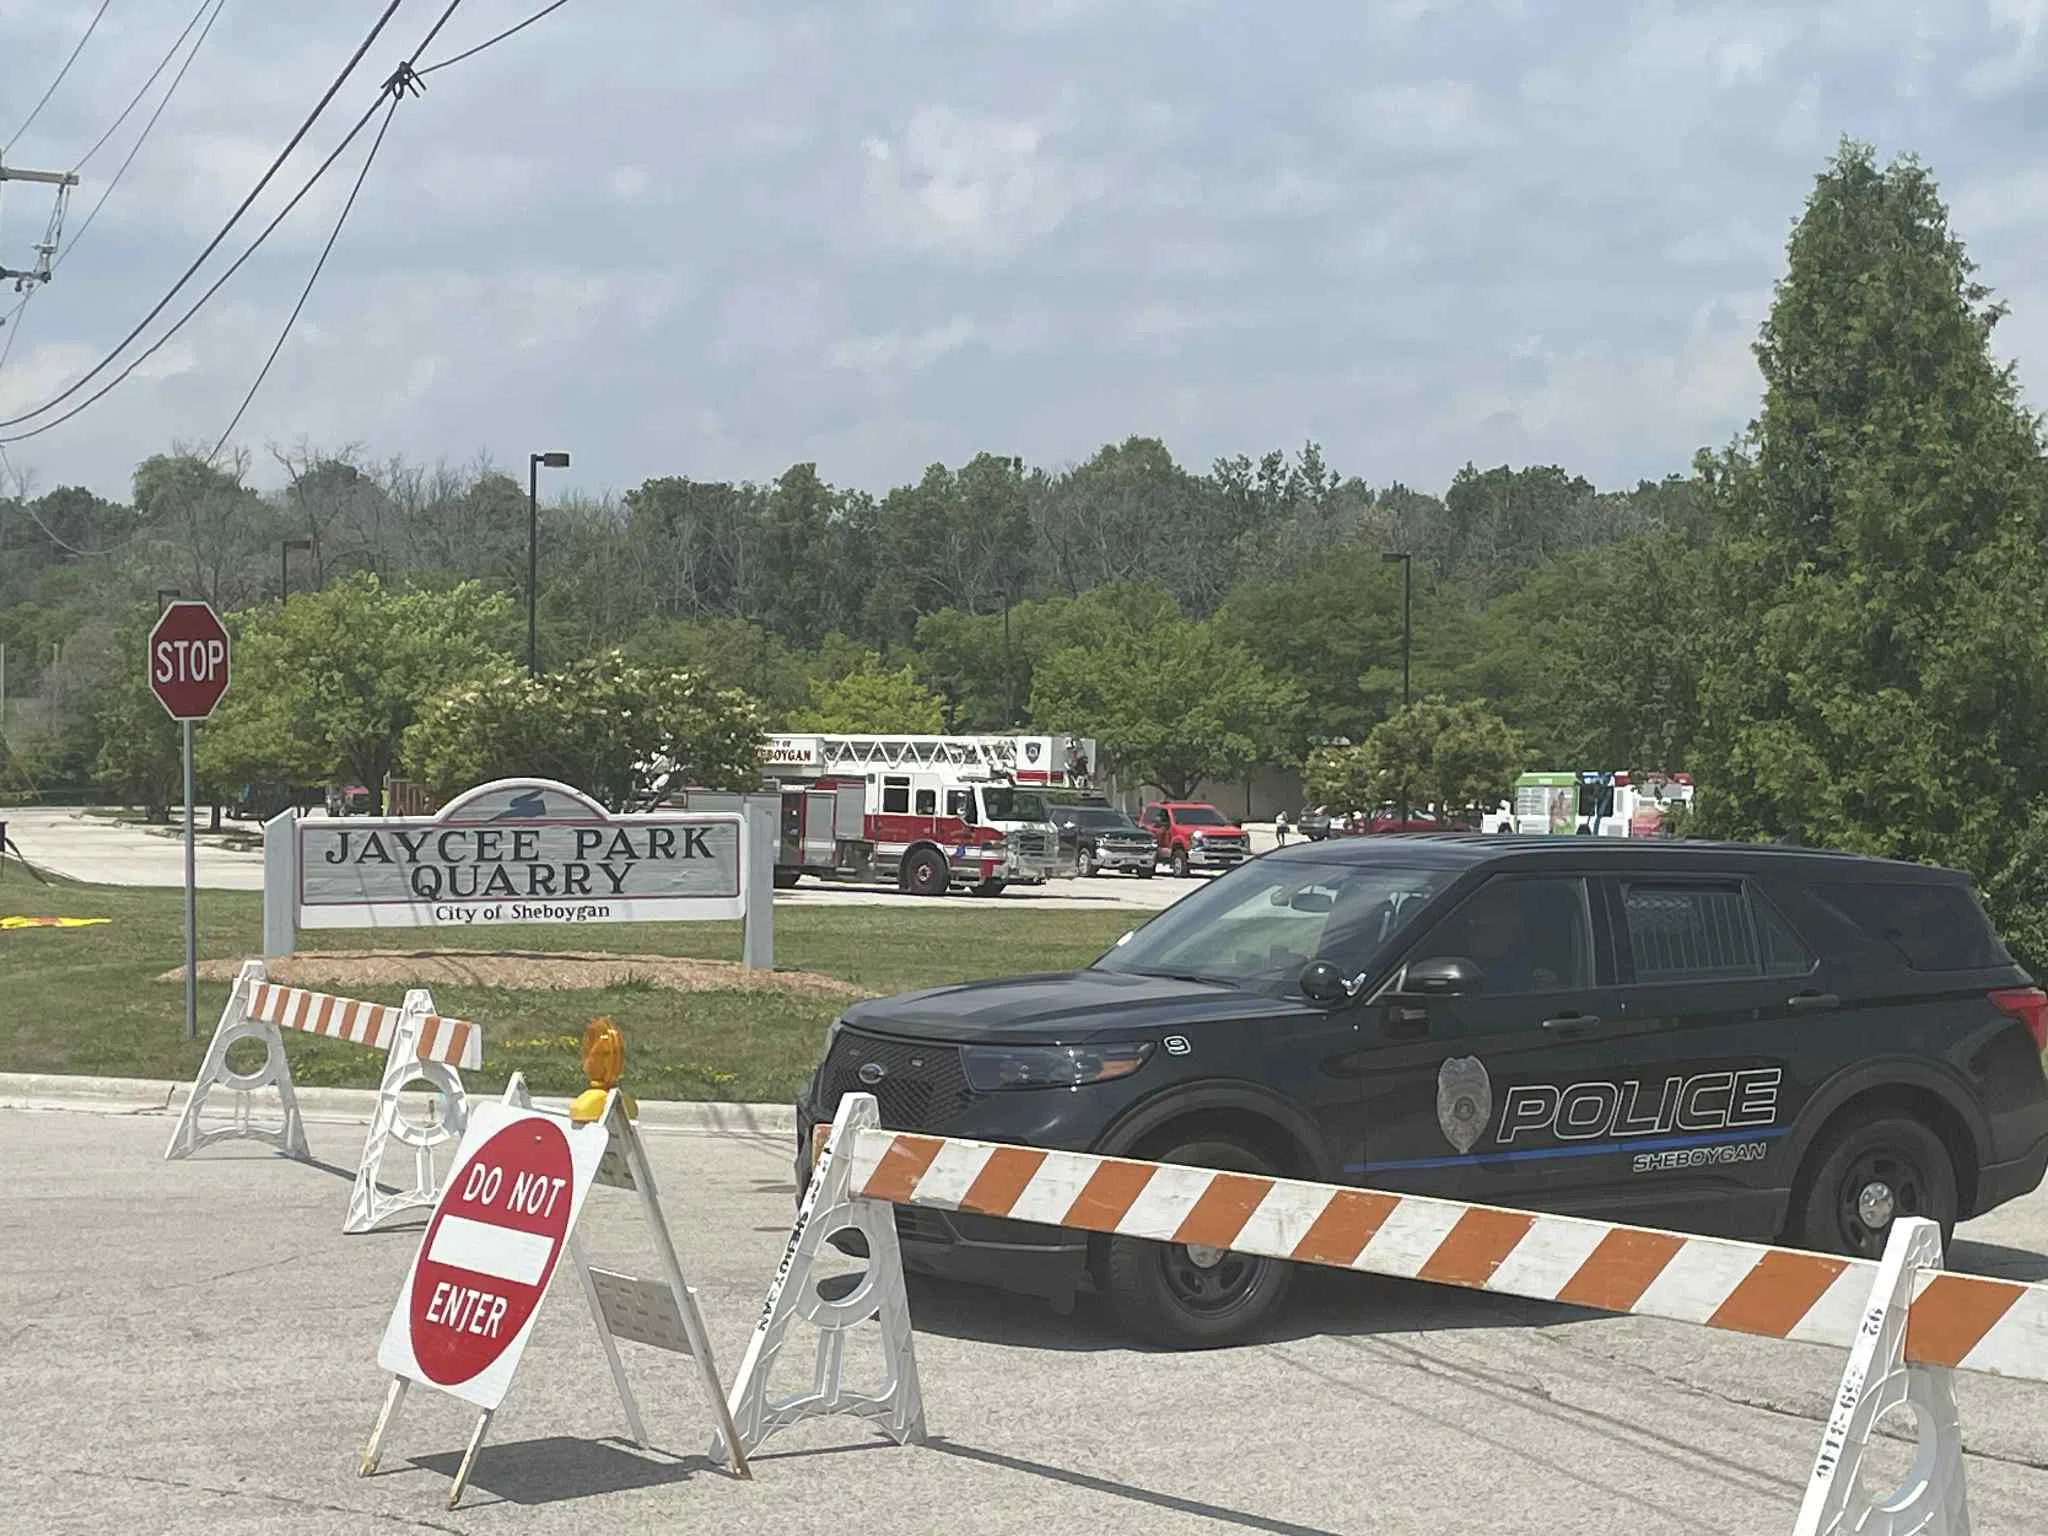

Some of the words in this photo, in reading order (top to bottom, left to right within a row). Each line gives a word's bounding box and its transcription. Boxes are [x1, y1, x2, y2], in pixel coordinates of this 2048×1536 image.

[156, 640, 224, 683] STOP
[325, 830, 540, 864] JAYCEE
[574, 827, 716, 861] PARK
[412, 861, 636, 902] QUARRY
[435, 904, 476, 925] City
[483, 903, 502, 920] of
[511, 903, 610, 924] Sheboygan
[1163, 1035, 1192, 1055] 9
[1496, 1068, 1783, 1144] POLICE
[1632, 1142, 1767, 1174] SHEBOYGAN
[462, 1163, 503, 1206] DO
[507, 1171, 566, 1219] NOT
[425, 1282, 508, 1339] ENTER
